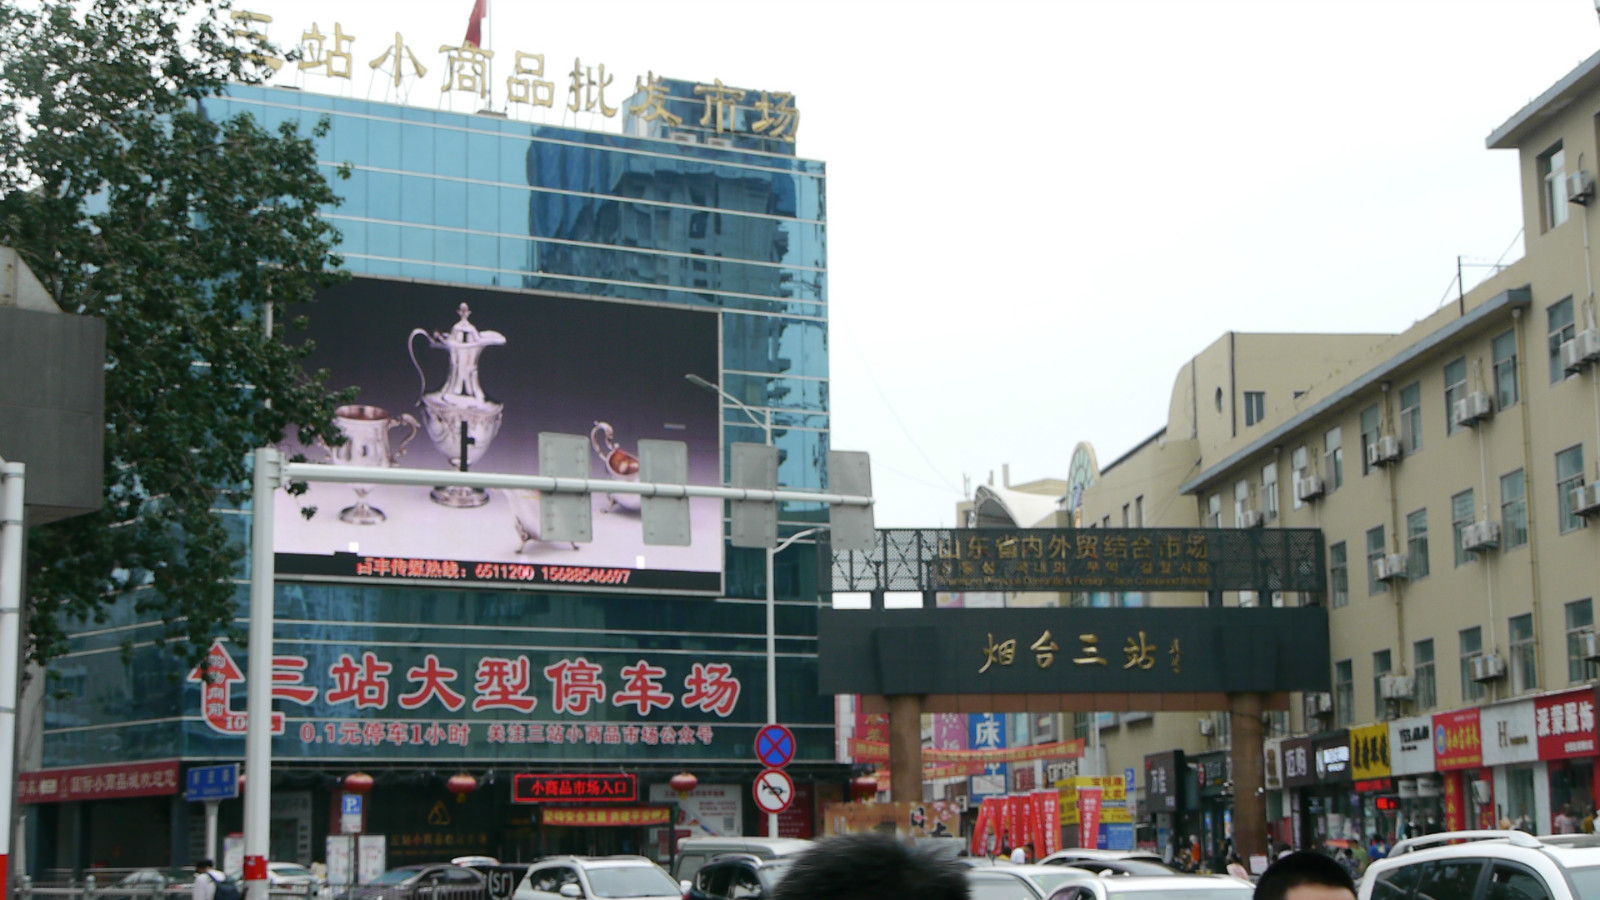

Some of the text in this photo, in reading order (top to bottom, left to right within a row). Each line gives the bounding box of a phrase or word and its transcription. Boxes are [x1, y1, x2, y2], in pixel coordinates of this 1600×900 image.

[231, 10, 801, 143] 三站小商品批发市场
[938, 533, 1210, 562] 山东省内外贸结合市场
[977, 629, 1157, 675] 烟台三站
[271, 651, 742, 719] 三站大型停车场
[299, 722, 471, 746] 0.1元停车1小时
[531, 779, 628, 797] 小商品市场入口
